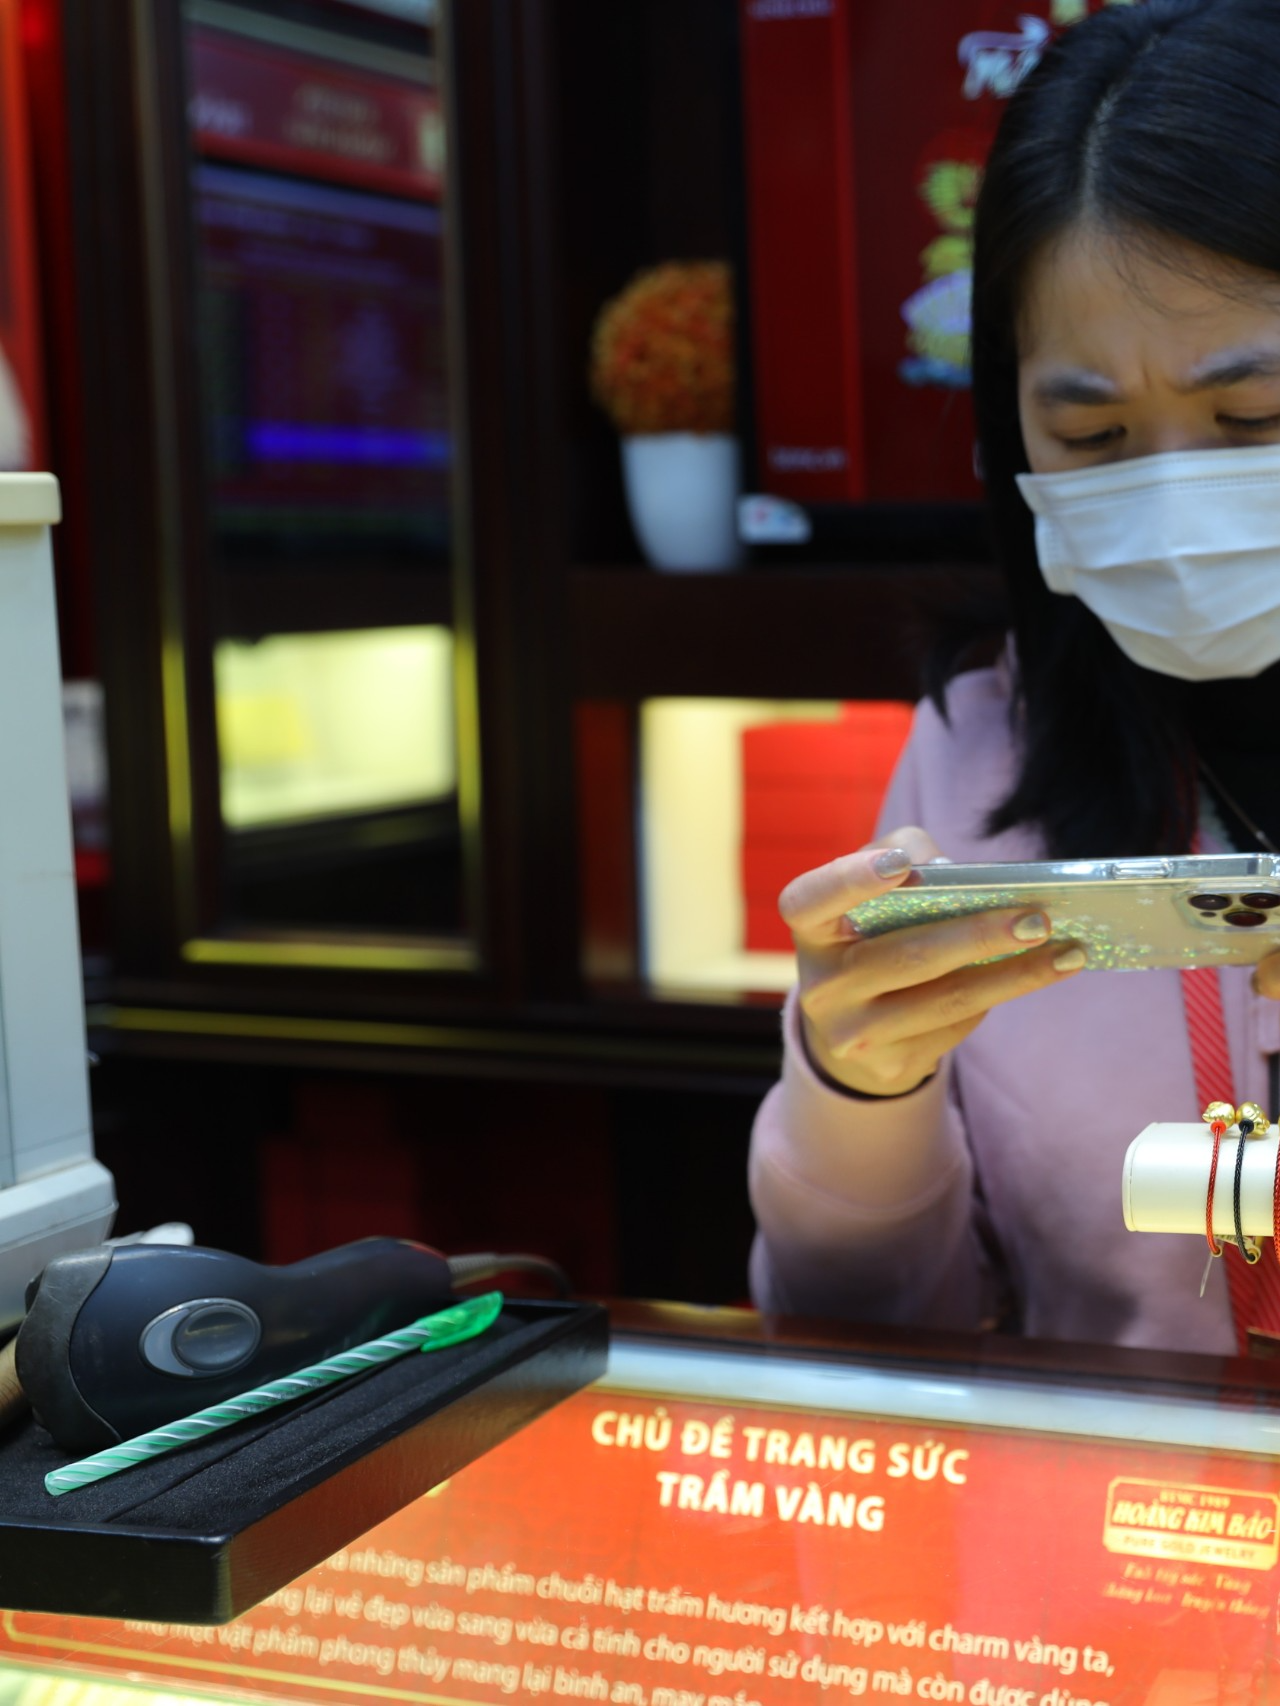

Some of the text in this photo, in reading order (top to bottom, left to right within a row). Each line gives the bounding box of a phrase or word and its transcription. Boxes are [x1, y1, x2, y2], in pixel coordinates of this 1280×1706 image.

[590, 1406, 673, 1452] CHỦ
[742, 1426, 876, 1475] TRANG
[886, 1439, 970, 1485] SỨC
[774, 1482, 886, 1532] VÀNG
[319, 1634, 396, 1676] phong
[452, 1656, 520, 1694] mang
[604, 1578, 645, 1615] hạt
[706, 1591, 788, 1636] hương
[789, 1603, 831, 1636] kết
[832, 1609, 884, 1648] hợp
[886, 1620, 927, 1649] với
[928, 1623, 1009, 1660] charm
[1013, 1635, 1078, 1675] vàng
[1081, 1645, 1115, 1678] ta,
[642, 1632, 691, 1664] cho
[692, 1644, 766, 1676] người
[800, 1654, 868, 1696] dụng
[872, 1666, 913, 1696] mà
[916, 1671, 965, 1703] còn
[1039, 1687, 1110, 1706] dù
